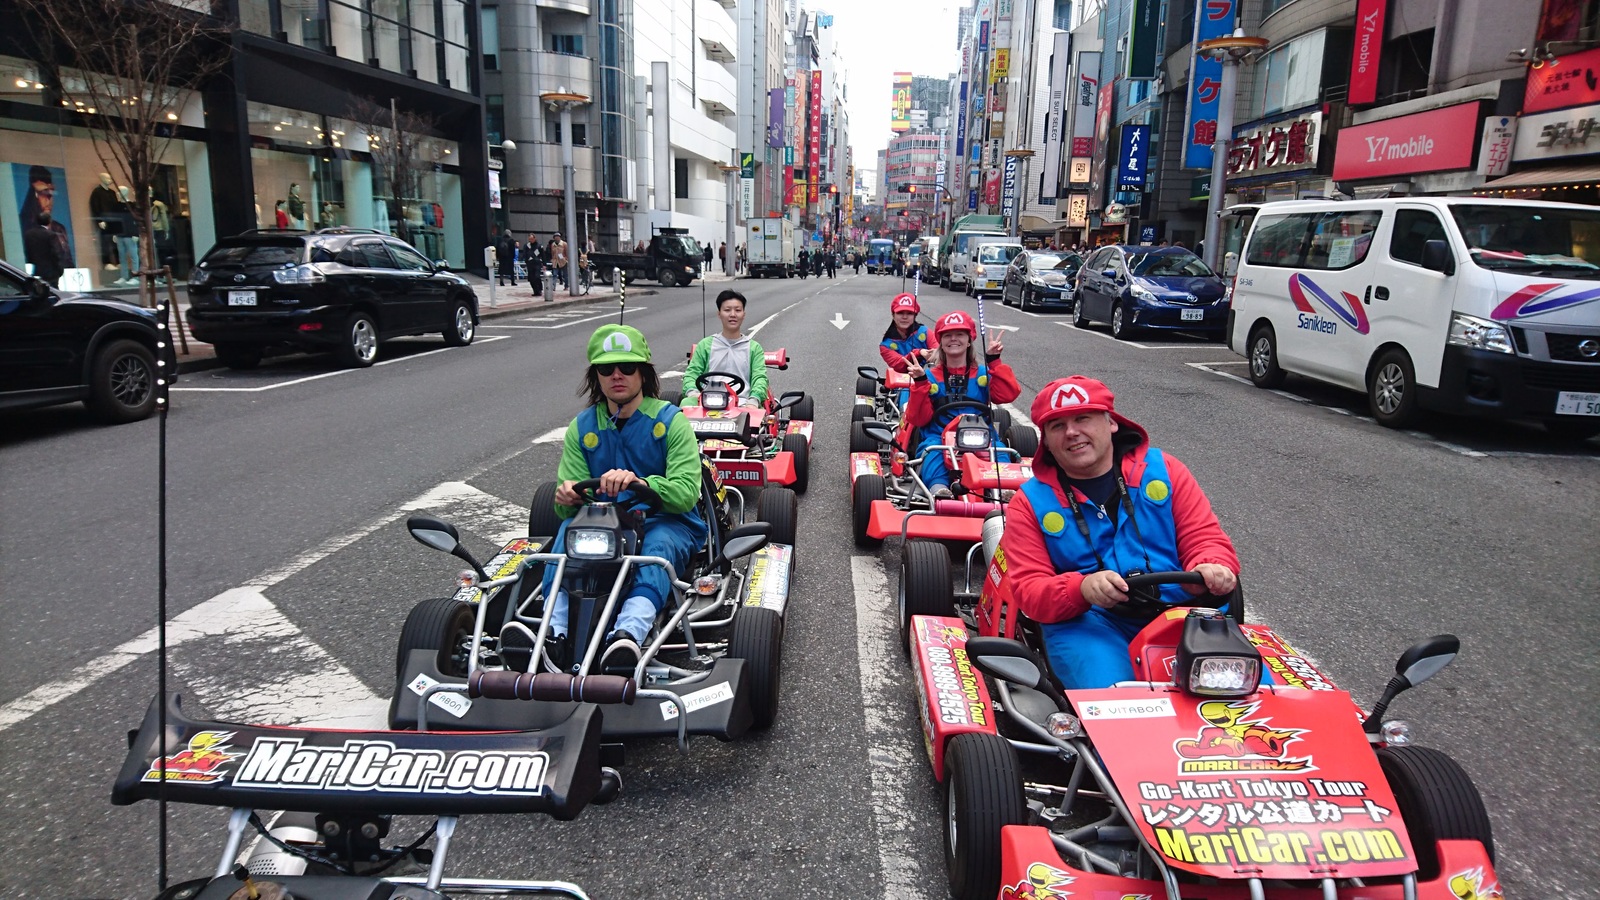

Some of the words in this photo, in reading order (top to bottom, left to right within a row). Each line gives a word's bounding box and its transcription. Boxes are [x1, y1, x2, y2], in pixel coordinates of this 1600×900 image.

[1358, 8, 1379, 73] Y!mobile
[1192, 0, 1232, 145] ラケ館
[1051, 116, 1060, 141] SELECT
[1128, 128, 1141, 171] 大戸屋
[1228, 120, 1308, 174] ラオケ館
[1365, 134, 1434, 163] Y!mobile
[946, 314, 963, 325] M
[1297, 313, 1338, 335] Sanikleen
[610, 335, 625, 350] L
[1054, 386, 1087, 409] M
[926, 646, 969, 726] 080-9999-2525
[961, 674, 980, 702] Tokyo
[433, 693, 462, 711] TABON
[685, 690, 725, 709] VITABON
[1108, 705, 1164, 715] VITABON
[967, 702, 987, 727] Tour
[243, 740, 545, 793] MariCar.com
[1184, 760, 1279, 773] MARICAR
[1140, 779, 1233, 800] Go-Kart
[1236, 779, 1308, 801] Tokyo
[1310, 779, 1367, 797] Tour
[1141, 800, 1391, 825] レンタル公道カート
[1155, 827, 1404, 864] MariCar.com
